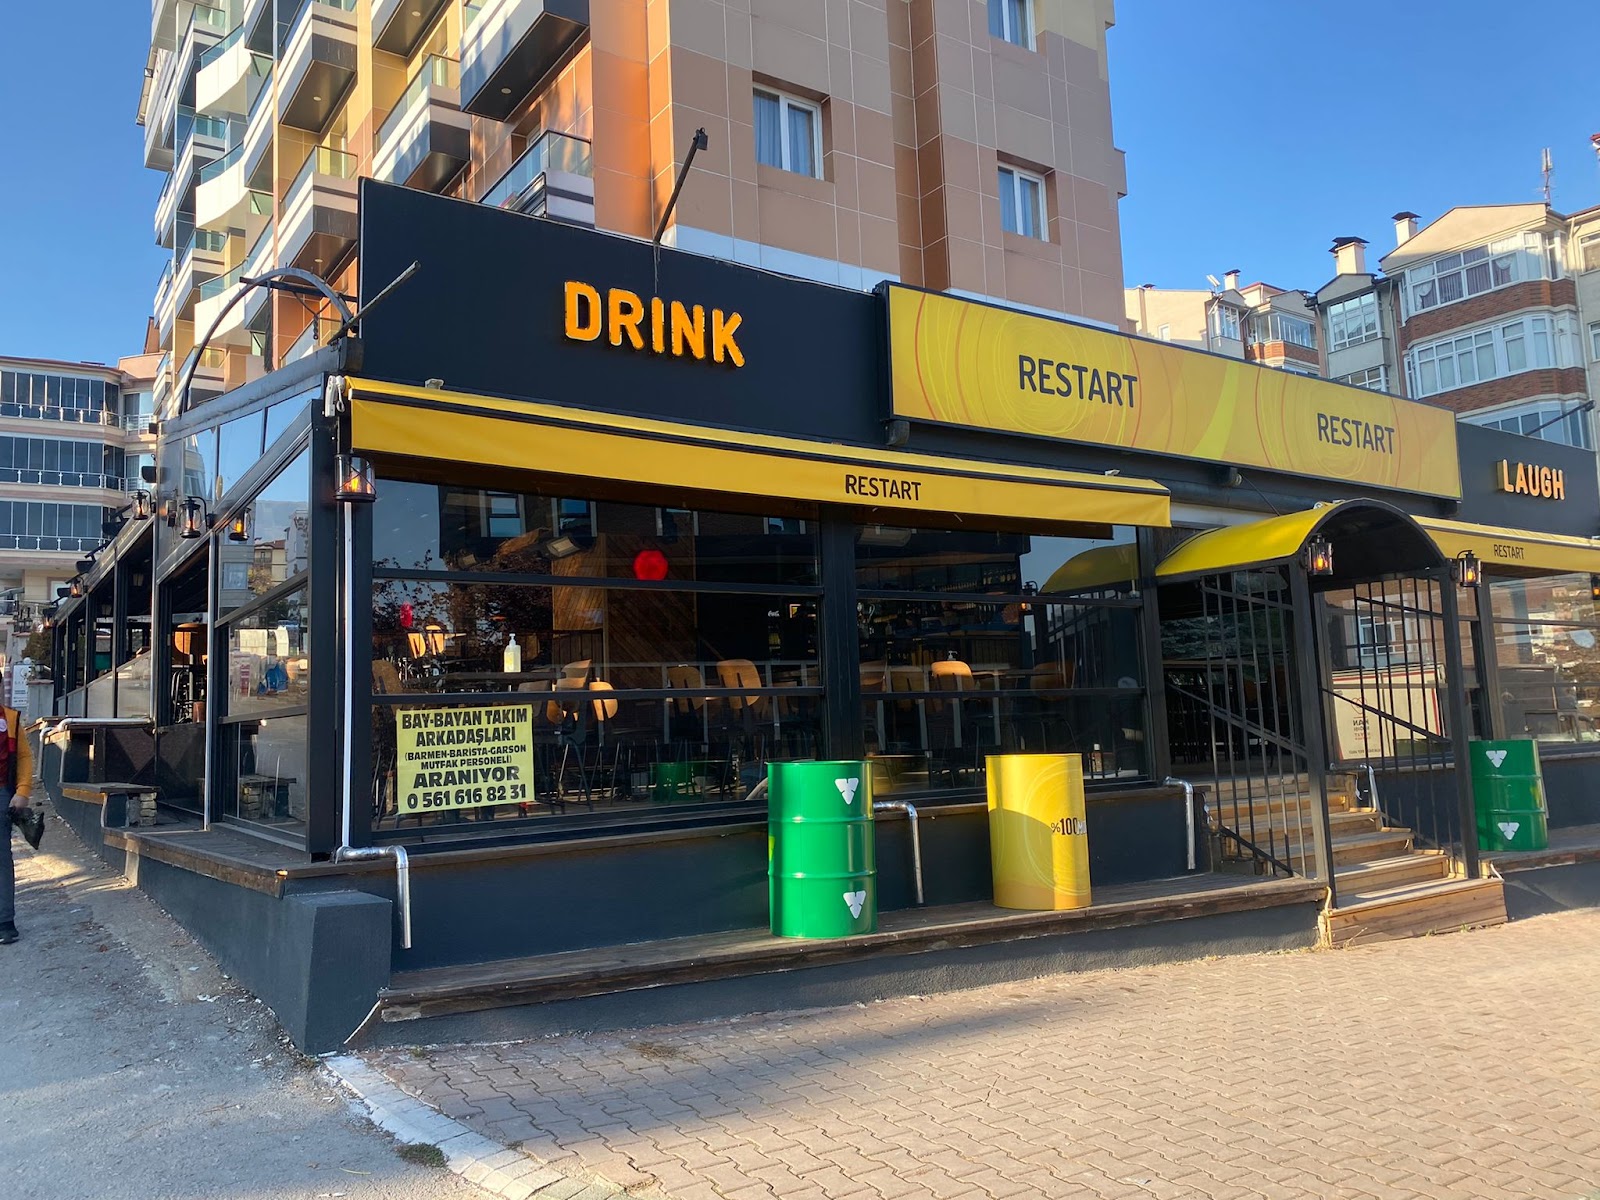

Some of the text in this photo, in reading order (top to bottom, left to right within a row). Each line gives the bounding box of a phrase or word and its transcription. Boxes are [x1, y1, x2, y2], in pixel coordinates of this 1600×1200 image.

[564, 279, 746, 368] DRINK
[1018, 354, 1138, 408] RESTART
[1317, 412, 1395, 455] RESTART
[845, 474, 921, 501] RESTART
[1501, 458, 1565, 501] LAUGH
[1493, 543, 1525, 560] RESTART
[402, 708, 527, 729] BAY-BAYAN TAKIM
[416, 726, 516, 747] ARKADAŞLARI
[421, 755, 512, 770] MUTFAK PERSONELİ)
[413, 766, 520, 789] ARANIYOR
[407, 784, 526, 809] 0 561 616 82 31
